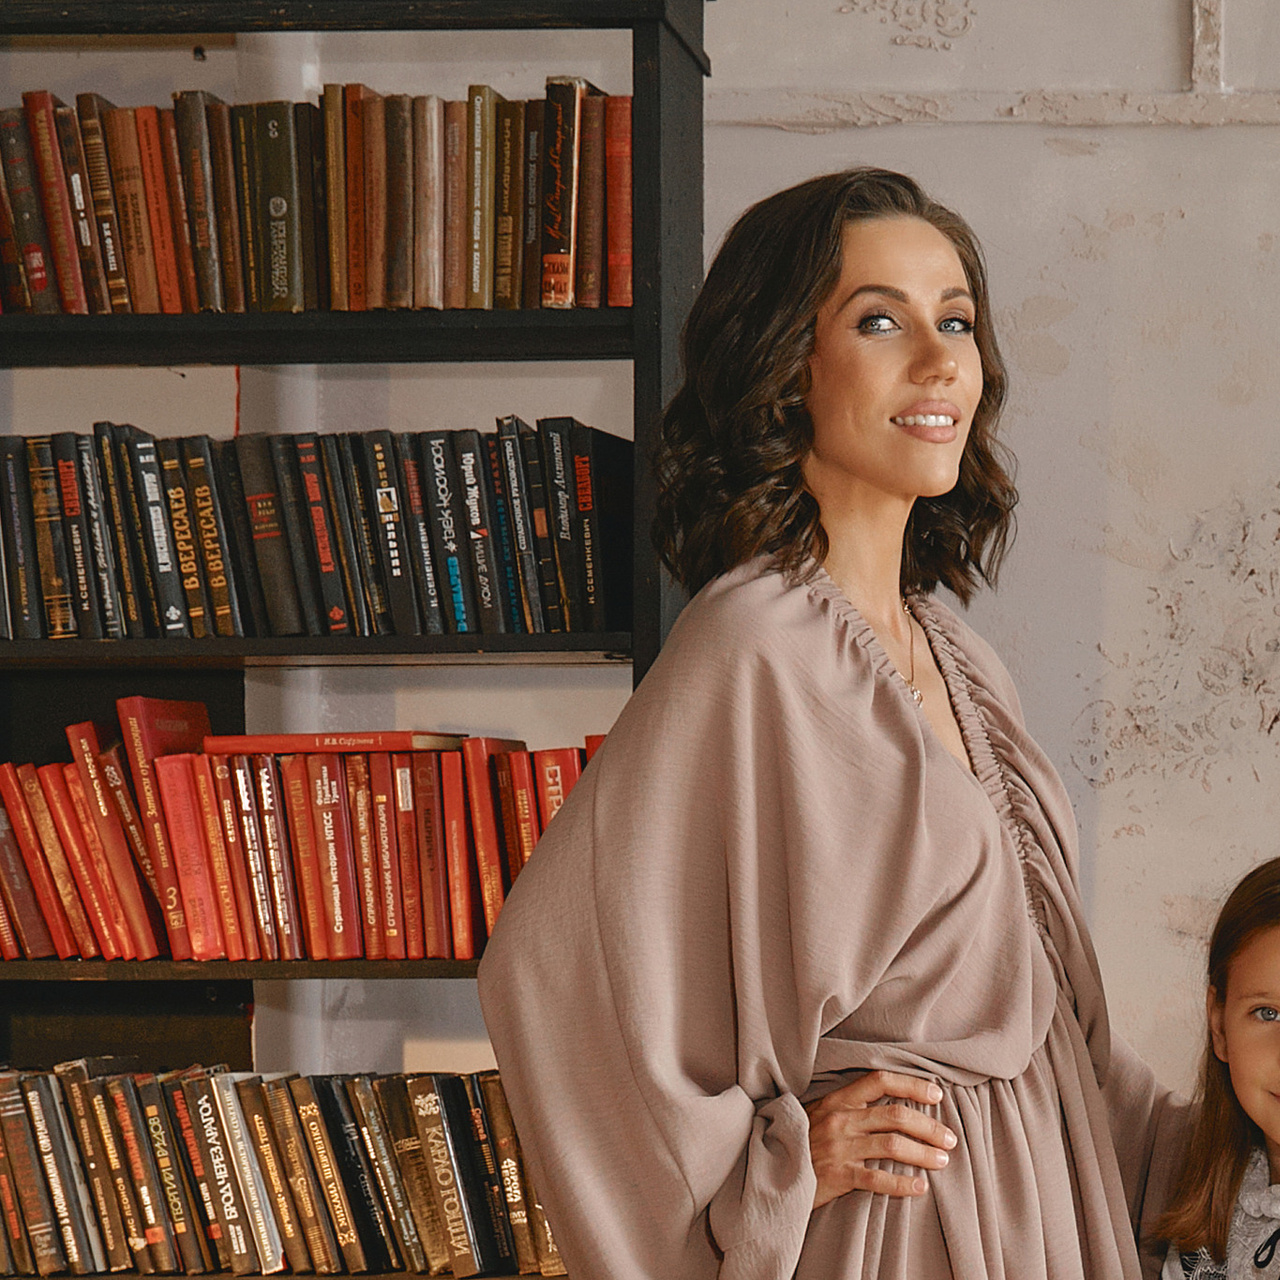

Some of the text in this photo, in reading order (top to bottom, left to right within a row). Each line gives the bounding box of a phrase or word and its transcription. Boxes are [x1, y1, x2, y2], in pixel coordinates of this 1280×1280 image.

[459, 451, 482, 527] Юрий Жуков
[558, 489, 570, 542] Владимир
[167, 485, 199, 591] В.ВЕРЕСАЕВ
[194, 483, 226, 589] В.ВЕРЕСАЕВ
[473, 538, 493, 609] НИЩИЕ ДУХОМ
[127, 714, 149, 770] революции
[141, 776, 156, 819] Записки
[320, 764, 331, 805] Проблемы
[322, 810, 343, 933] Страницы истории КПСС
[377, 802, 395, 928] СПРАВОЧНИК БИБЛИОТЕКАРЯ
[166, 886, 178, 910] 3
[362, 865, 378, 925] СПРАВОЧНАЯ
[209, 1144, 229, 1185] ЧЕРЕЗ
[306, 1119, 348, 1228] МИХАИЛ ШЕВЧЕНКО
[421, 1122, 476, 1258] КАРЛО ГОЦЦИ
[499, 1158, 513, 1203] ЧЕСТИ
[507, 1156, 521, 1203] ДОРОГА
[216, 1182, 238, 1221] БРОД
